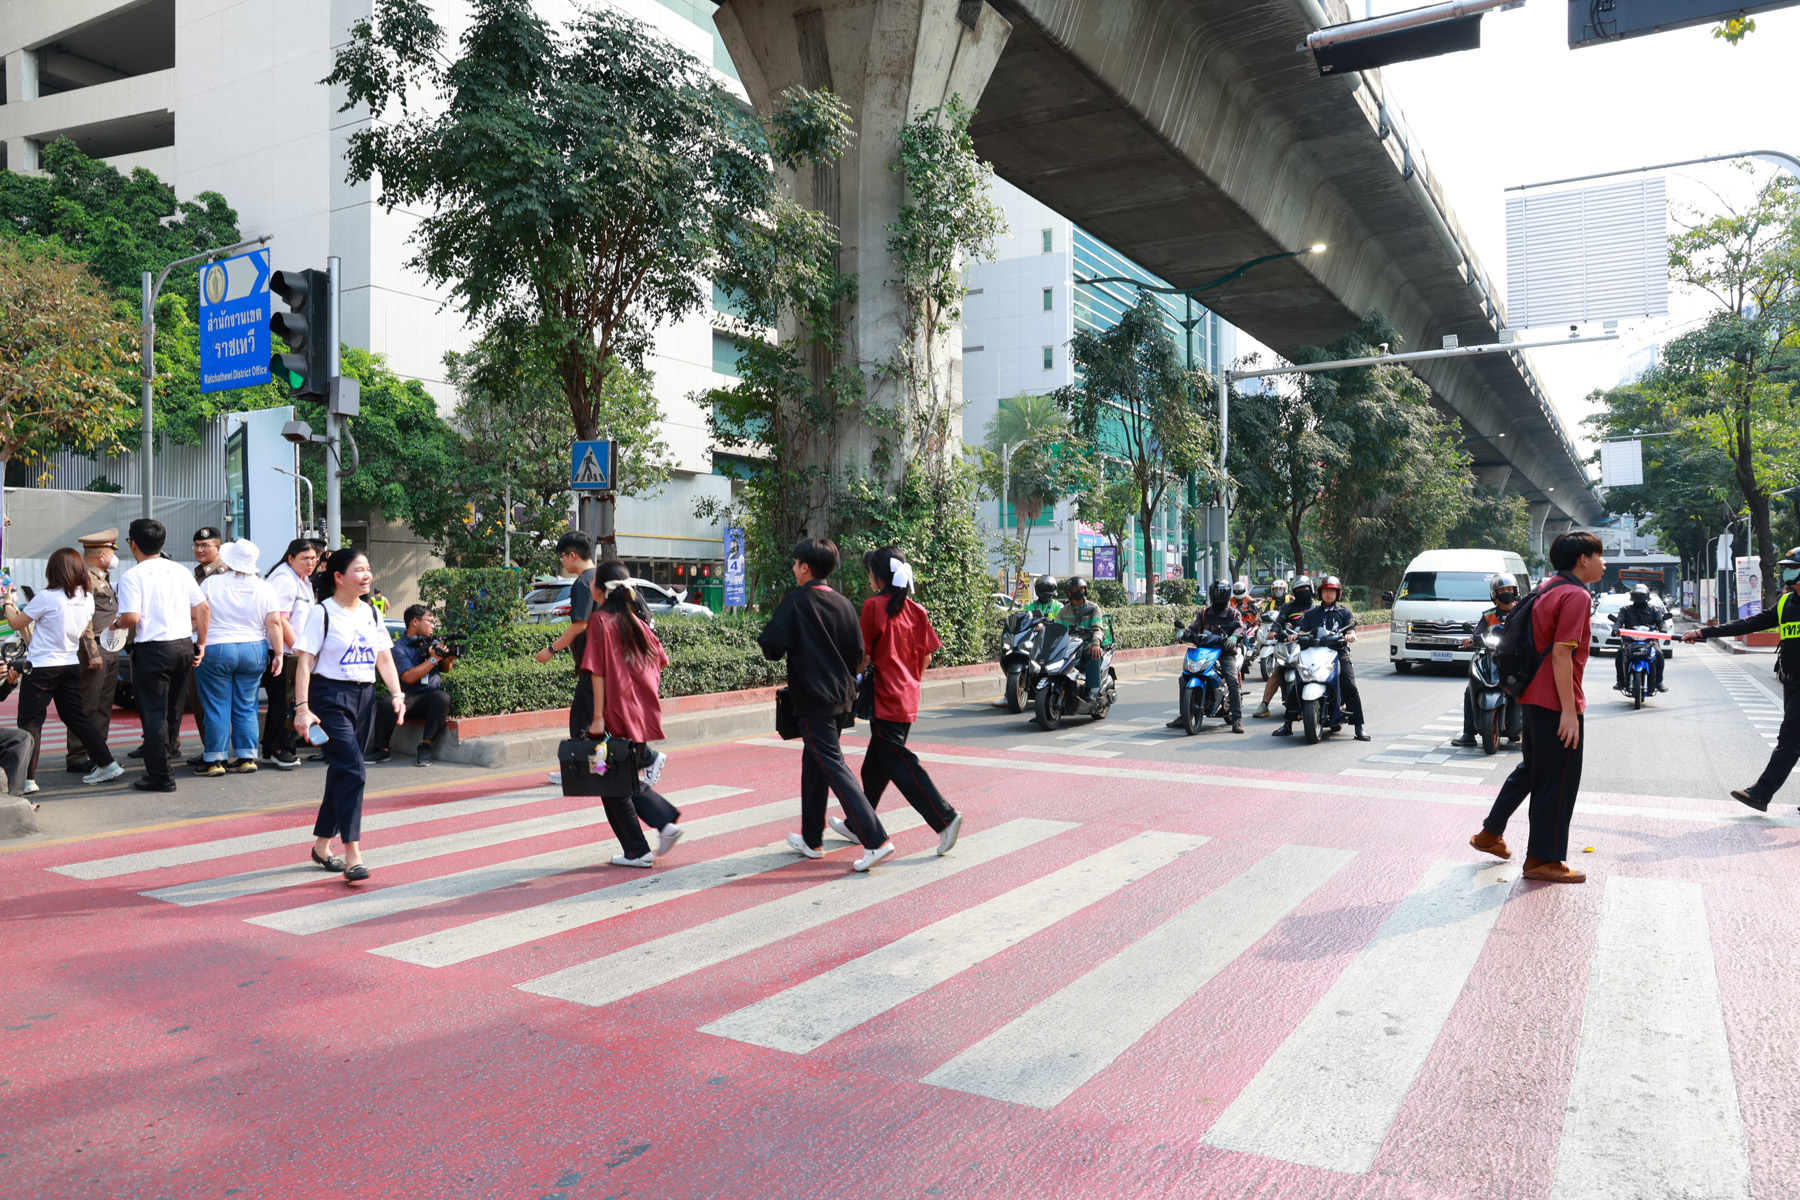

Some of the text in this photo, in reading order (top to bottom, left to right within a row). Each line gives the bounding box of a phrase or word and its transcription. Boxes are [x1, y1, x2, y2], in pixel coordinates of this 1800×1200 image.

[207, 307, 262, 332] สำนักงานเขต
[214, 328, 255, 359] ราชเทวี
[204, 365, 268, 384] Ratchathewi District Office
[730, 560, 739, 571] 4
